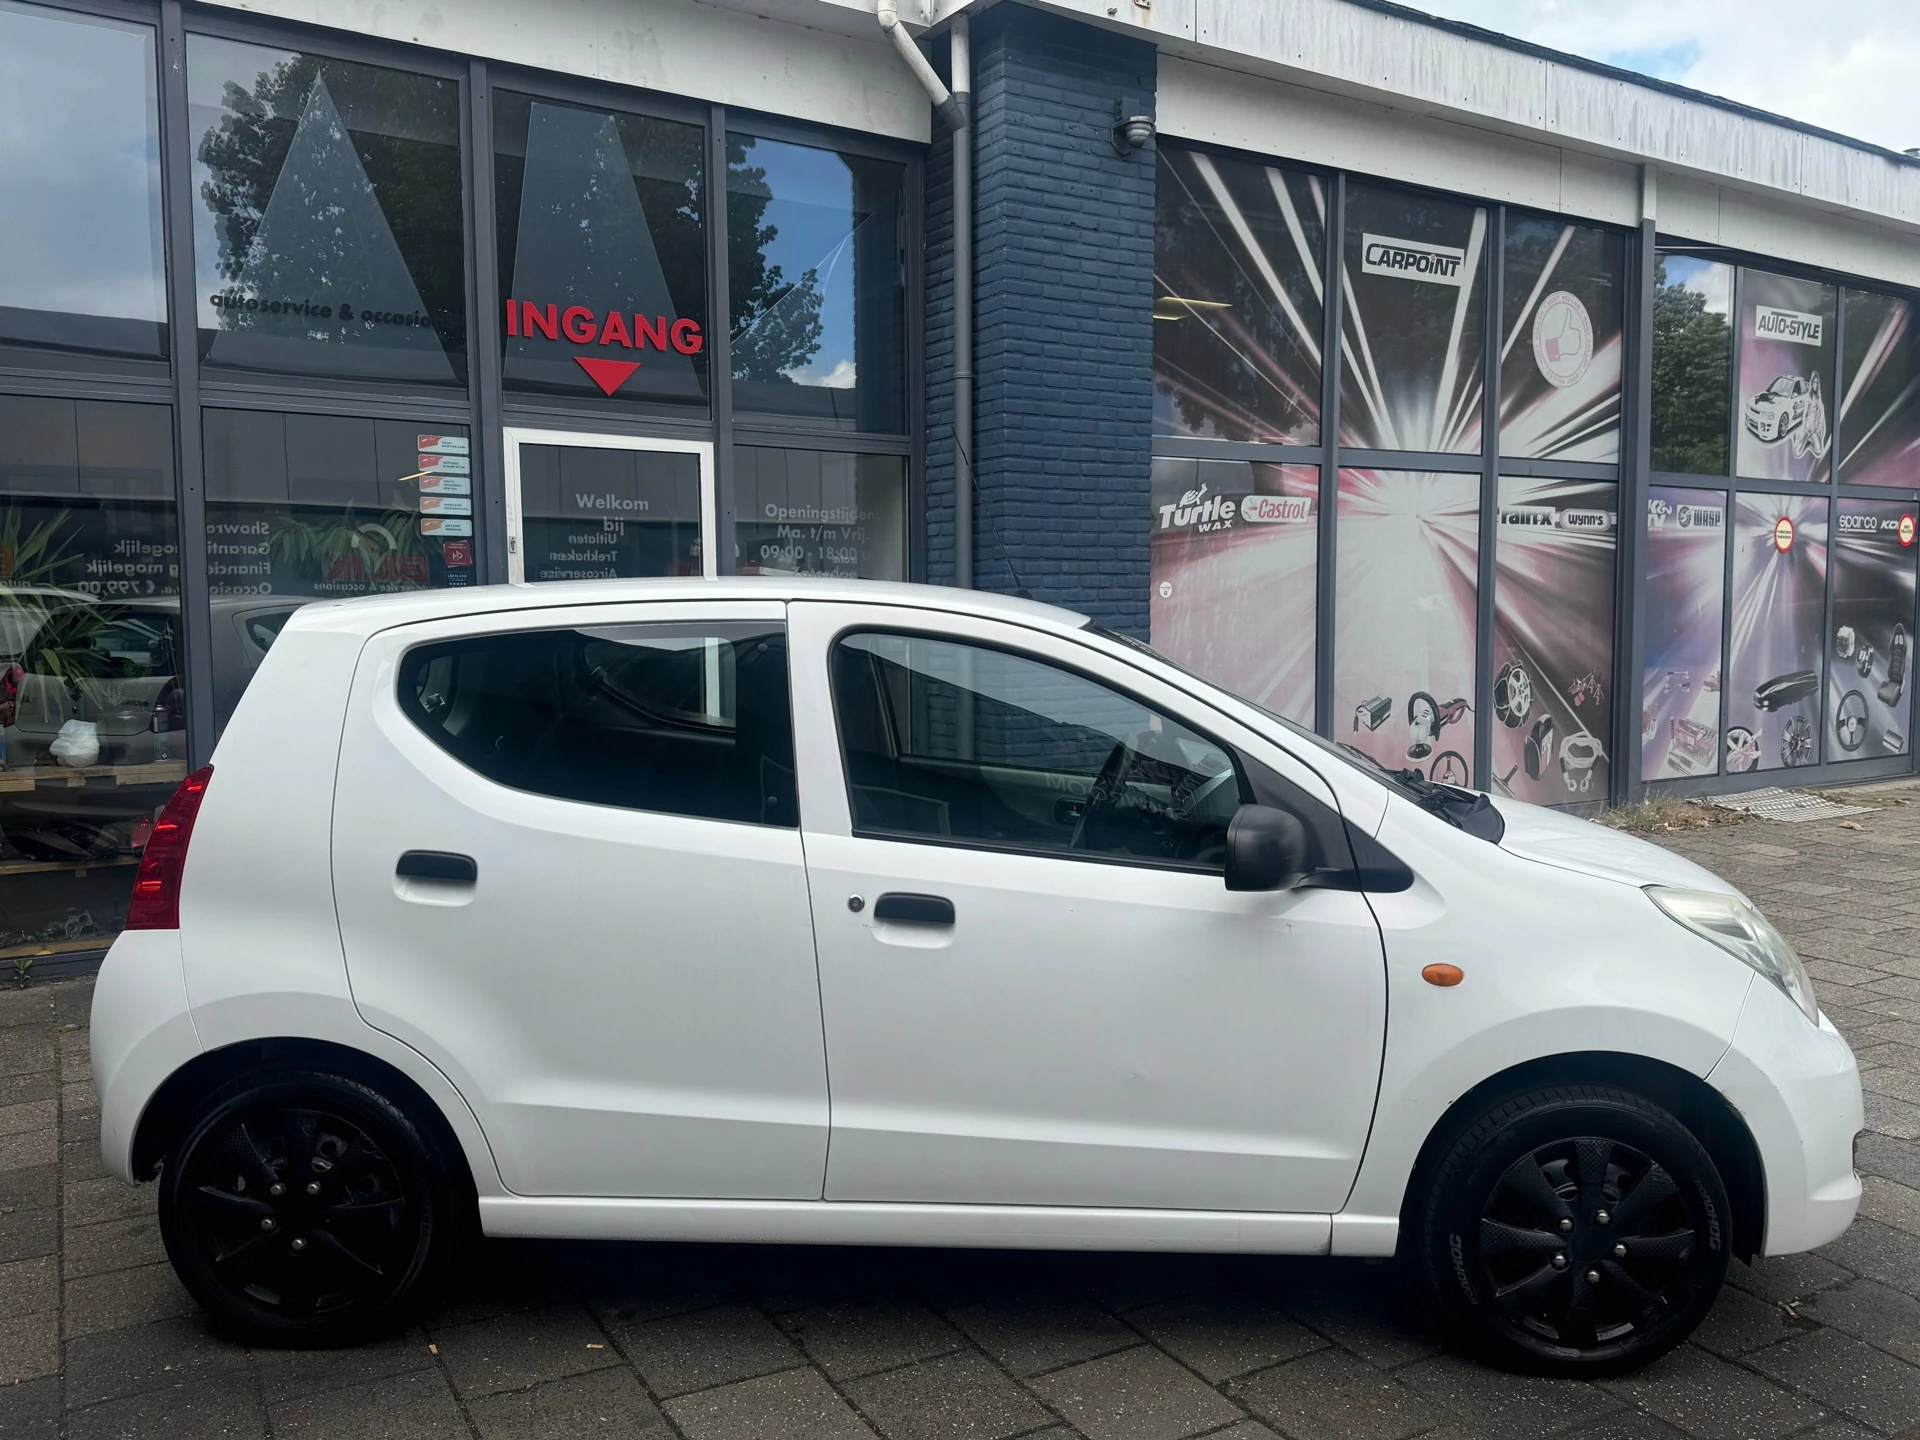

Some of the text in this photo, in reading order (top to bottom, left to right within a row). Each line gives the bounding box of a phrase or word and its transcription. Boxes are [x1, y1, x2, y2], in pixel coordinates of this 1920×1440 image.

[210, 294, 332, 319] autoservice
[338, 303, 354, 320] &
[506, 299, 703, 355] INGANG
[1757, 311, 1821, 341] AUTO-STYLE
[575, 494, 649, 511] Welkom
[1159, 495, 1236, 529] Turtle
[1258, 499, 1306, 520] Castrol
[764, 503, 881, 523] Openingstijden:
[603, 517, 625, 536] bij
[1198, 520, 1233, 533] WAX
[1838, 515, 1878, 533] sparco
[777, 525, 870, 544] Ma. t/m Vrij.
[760, 545, 804, 559] 09:00
